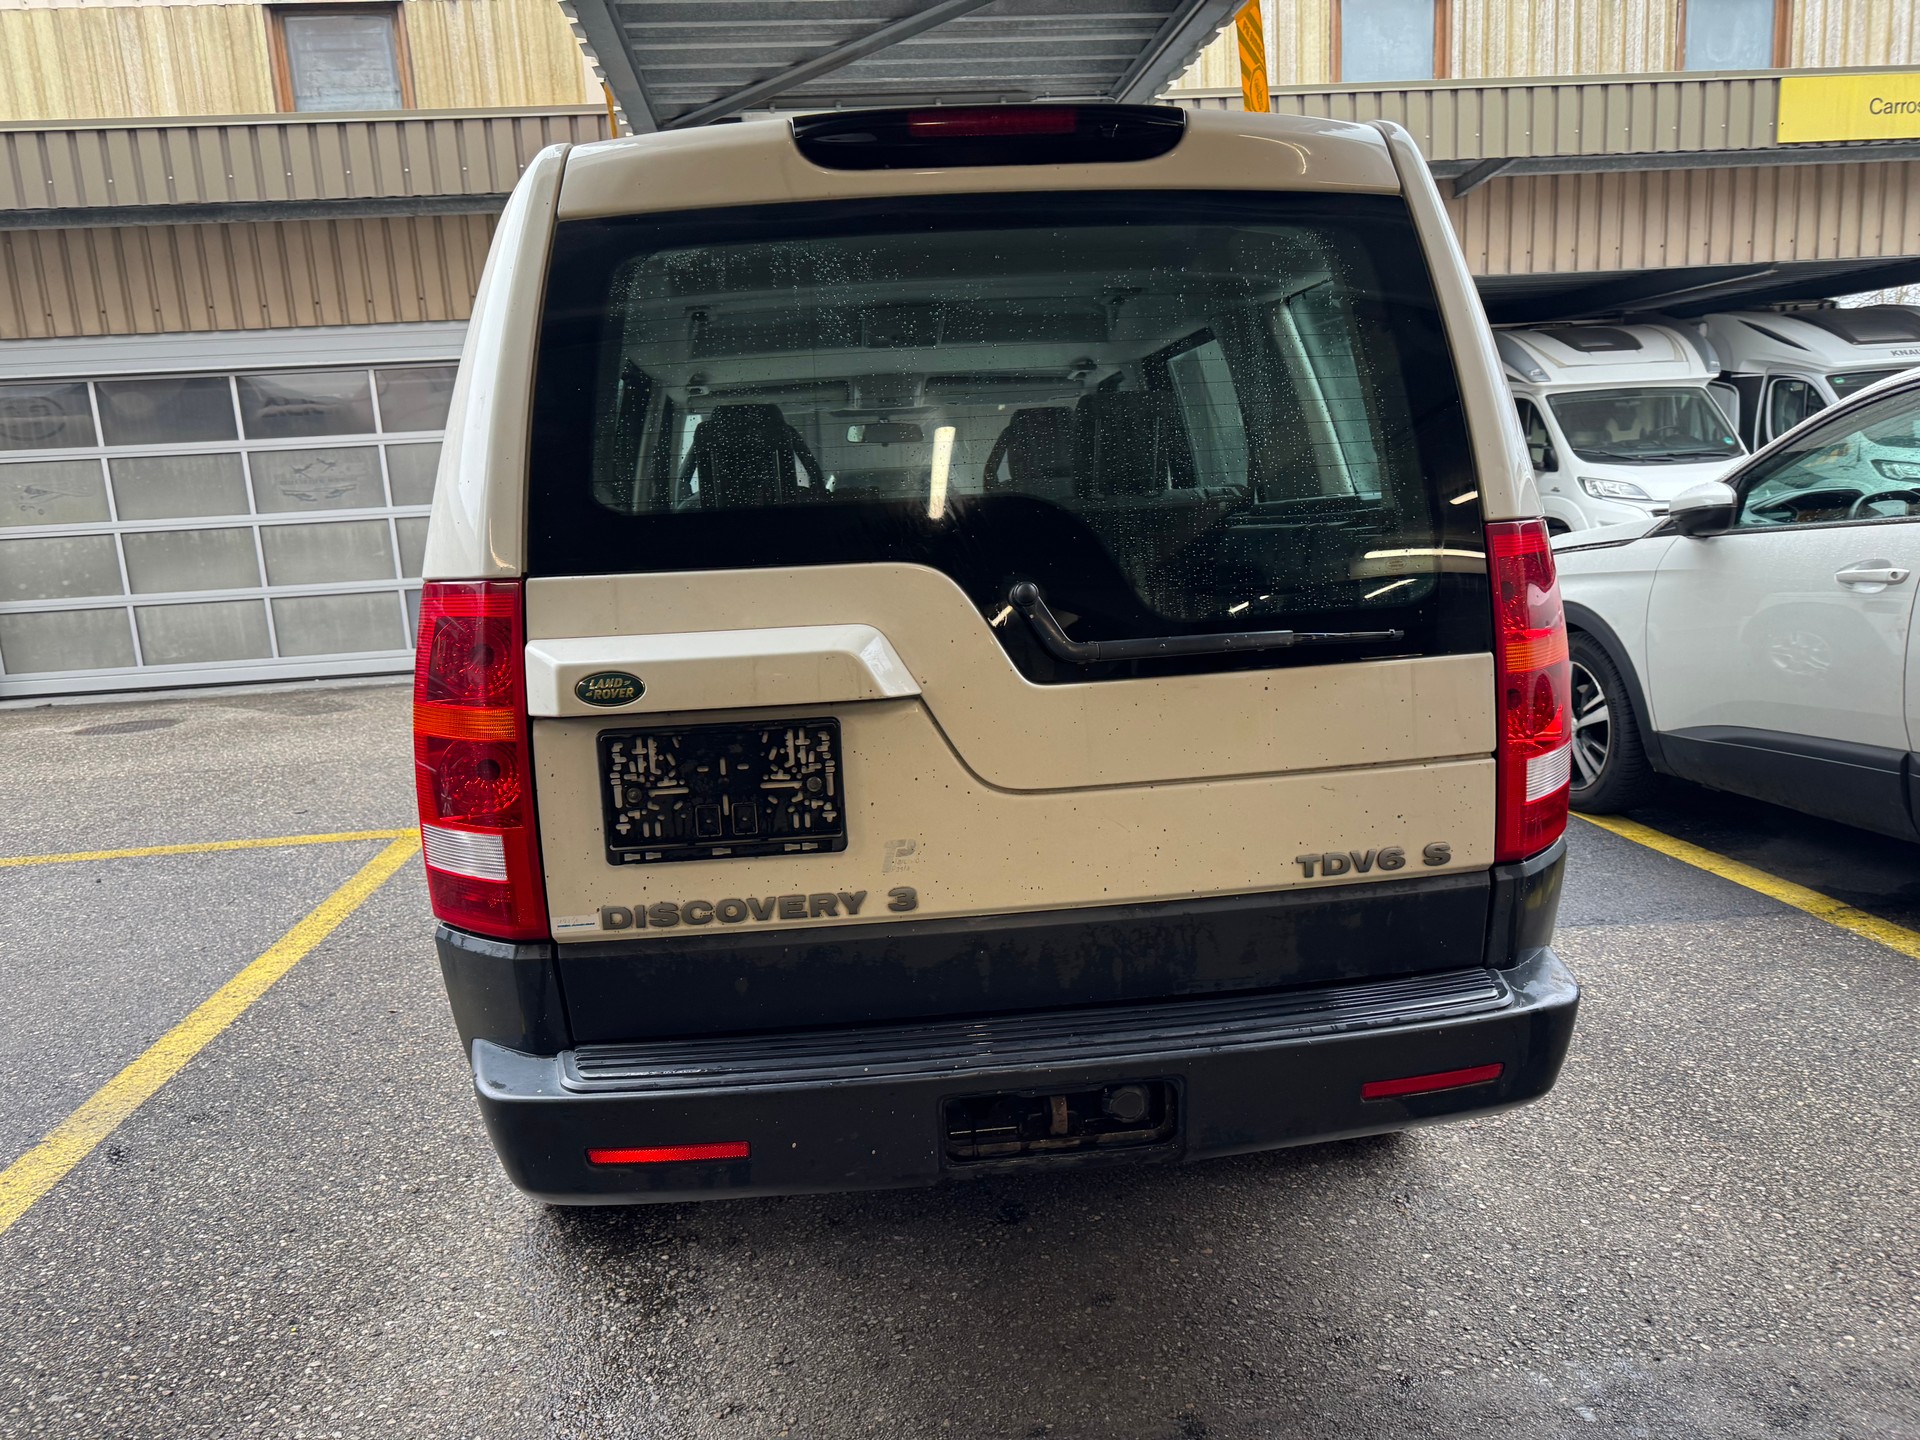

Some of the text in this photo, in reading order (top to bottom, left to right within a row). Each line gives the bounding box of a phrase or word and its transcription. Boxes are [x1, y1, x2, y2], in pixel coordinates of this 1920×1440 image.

[588, 677, 623, 690] LAND
[593, 687, 635, 700] ROVER
[1296, 841, 1452, 878] TDV6 S
[602, 886, 918, 931] DISCOVERY 3
